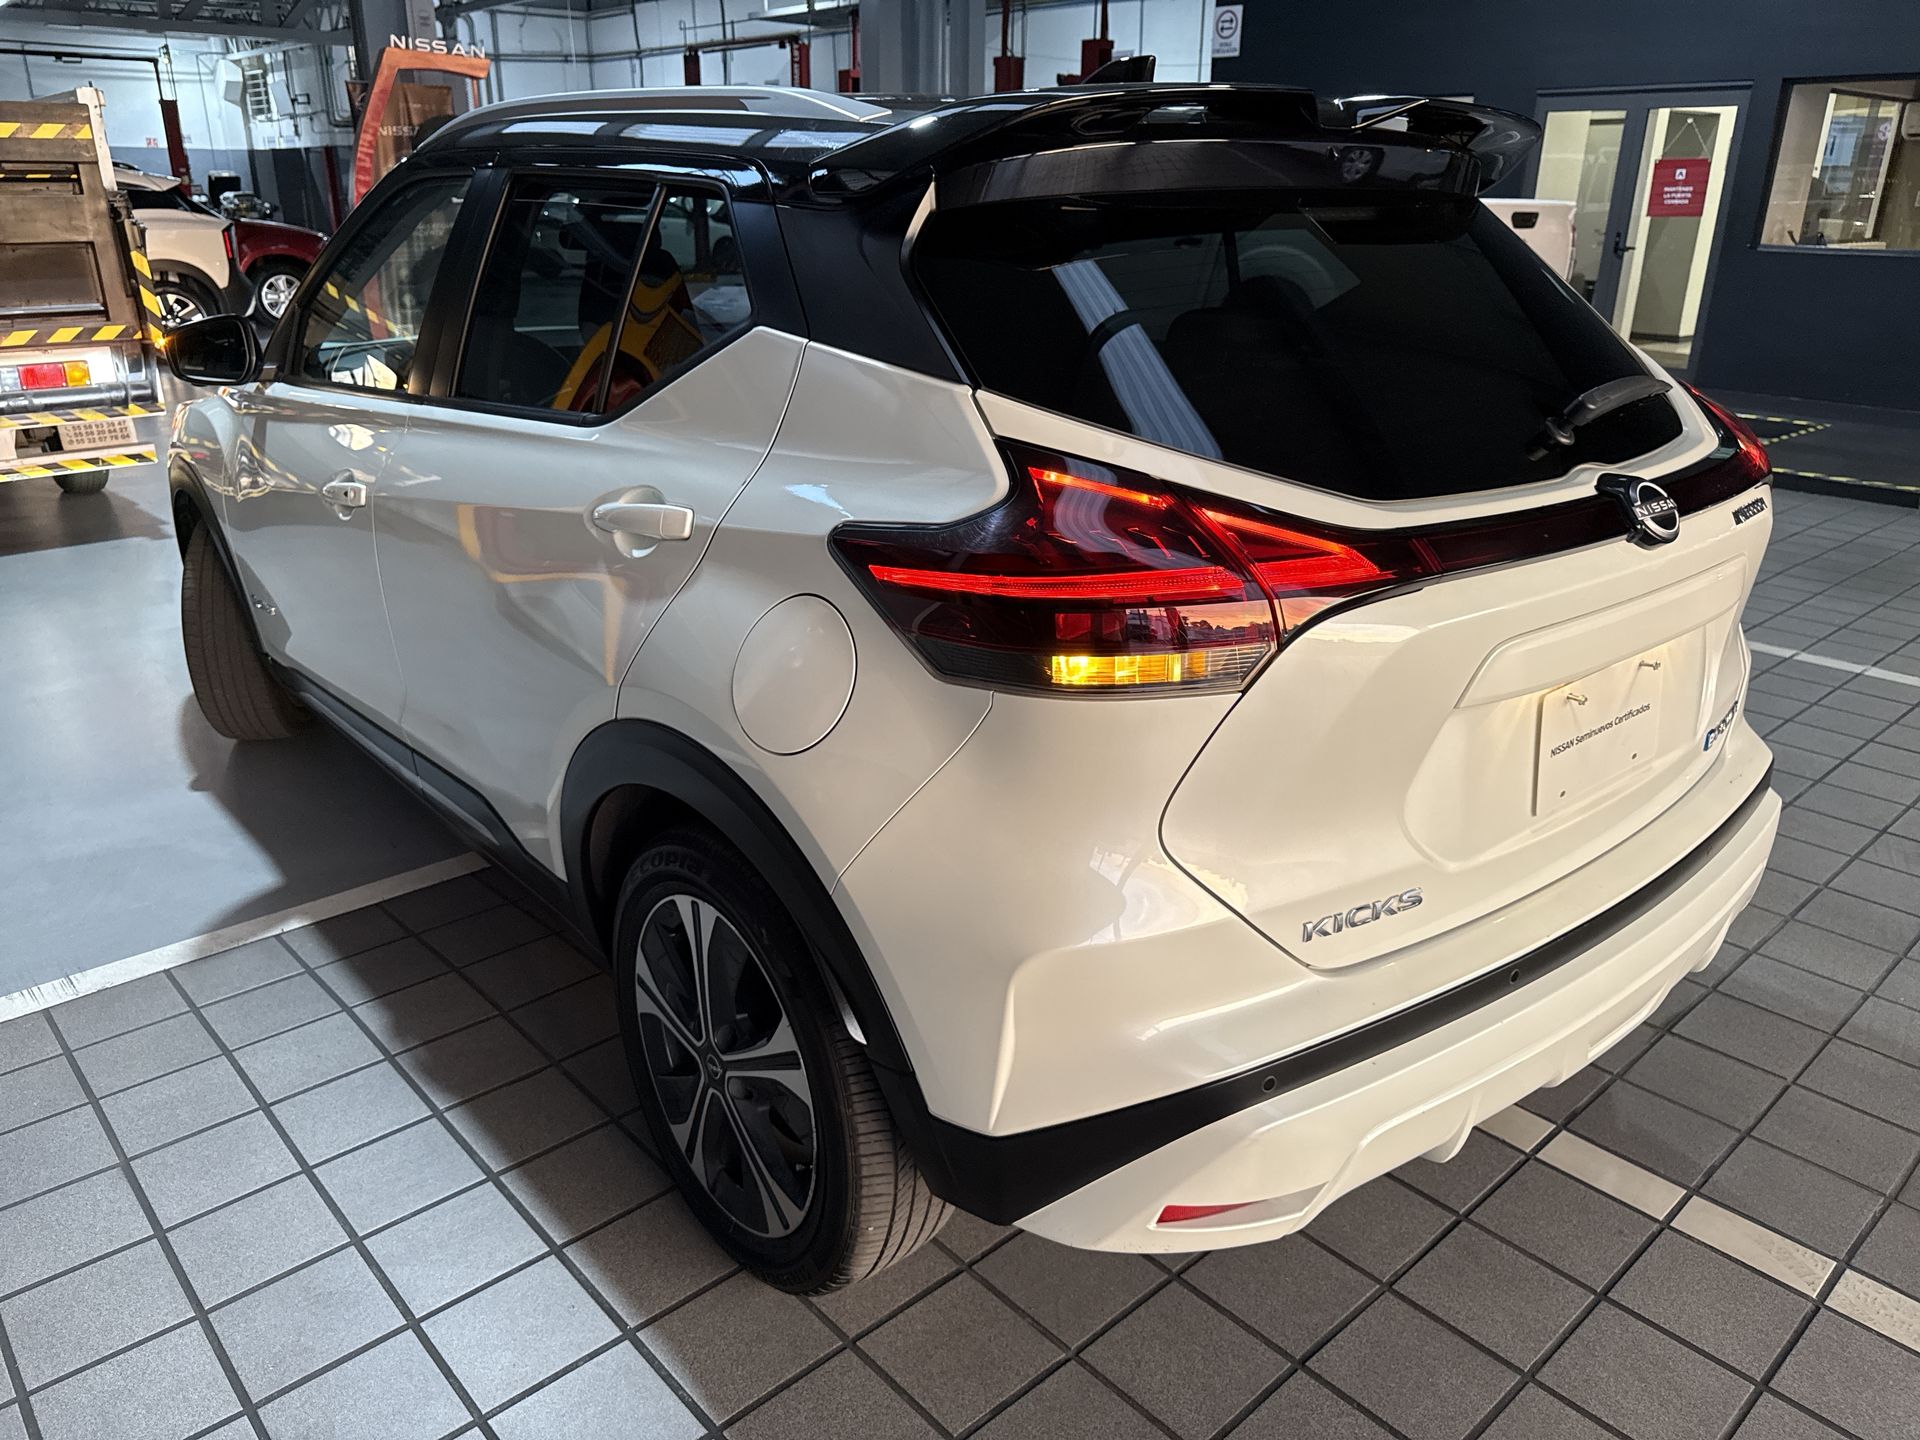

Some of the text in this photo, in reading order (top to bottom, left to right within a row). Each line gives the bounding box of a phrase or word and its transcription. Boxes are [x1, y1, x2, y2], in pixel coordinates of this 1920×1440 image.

[389, 33, 486, 59] NISSAN
[1550, 703, 1651, 758] NISSAN Seminuevos Certificados
[1302, 886, 1423, 943] KICKS
